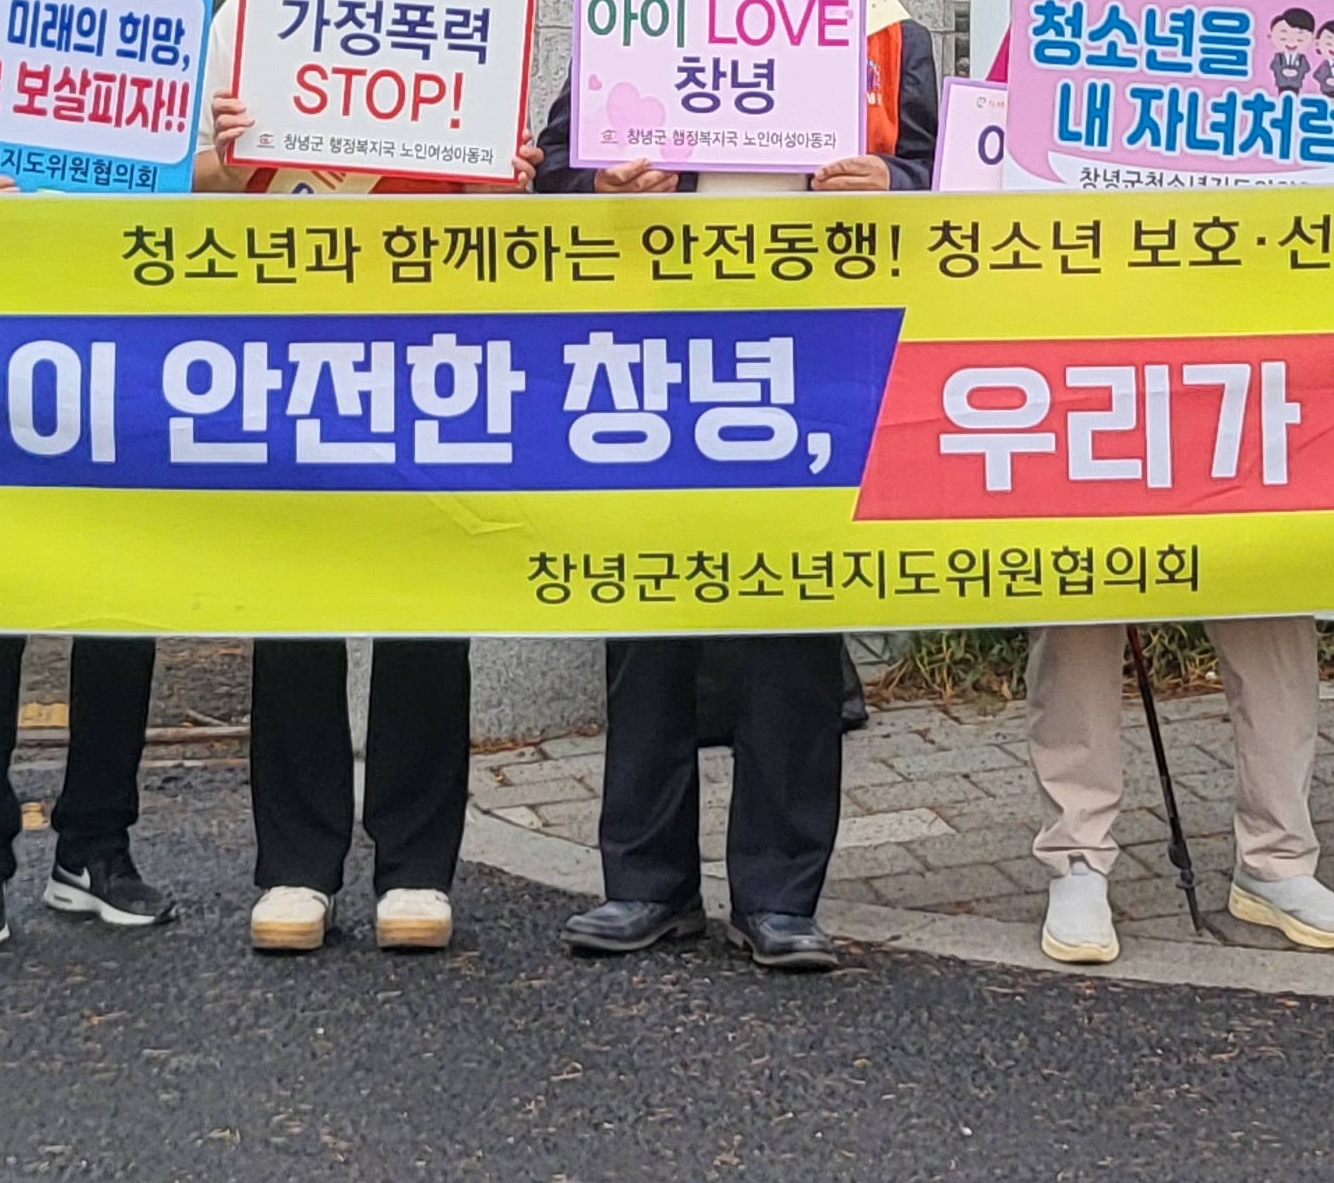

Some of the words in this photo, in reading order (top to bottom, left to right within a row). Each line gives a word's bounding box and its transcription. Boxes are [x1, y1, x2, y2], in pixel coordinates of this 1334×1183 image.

[115, 11, 191, 72] 희망,
[1031, 0, 1253, 77] 청소년을
[13, 61, 190, 133] 보살피자!!
[292, 63, 464, 130] STOP!
[674, 56, 776, 115] 창녕
[1058, 82, 1112, 148] 내
[283, 133, 324, 152] 창녕군
[329, 136, 397, 158] 행정복지국
[400, 140, 495, 166] 노인여성아동과
[627, 128, 667, 146] 창녕군
[672, 129, 739, 148] 행정복지국
[743, 131, 837, 150] 노인여성아동과
[122, 224, 361, 285] 청소년과
[382, 223, 620, 284] 함께하는
[641, 221, 901, 281] 안전동행!
[926, 219, 1103, 278] 청소년
[163, 332, 525, 464] 안전한
[563, 330, 832, 475] 창녕,
[938, 360, 1301, 493] 우리가
[526, 543, 1200, 605] 창녕군청소년지도위원협의회
